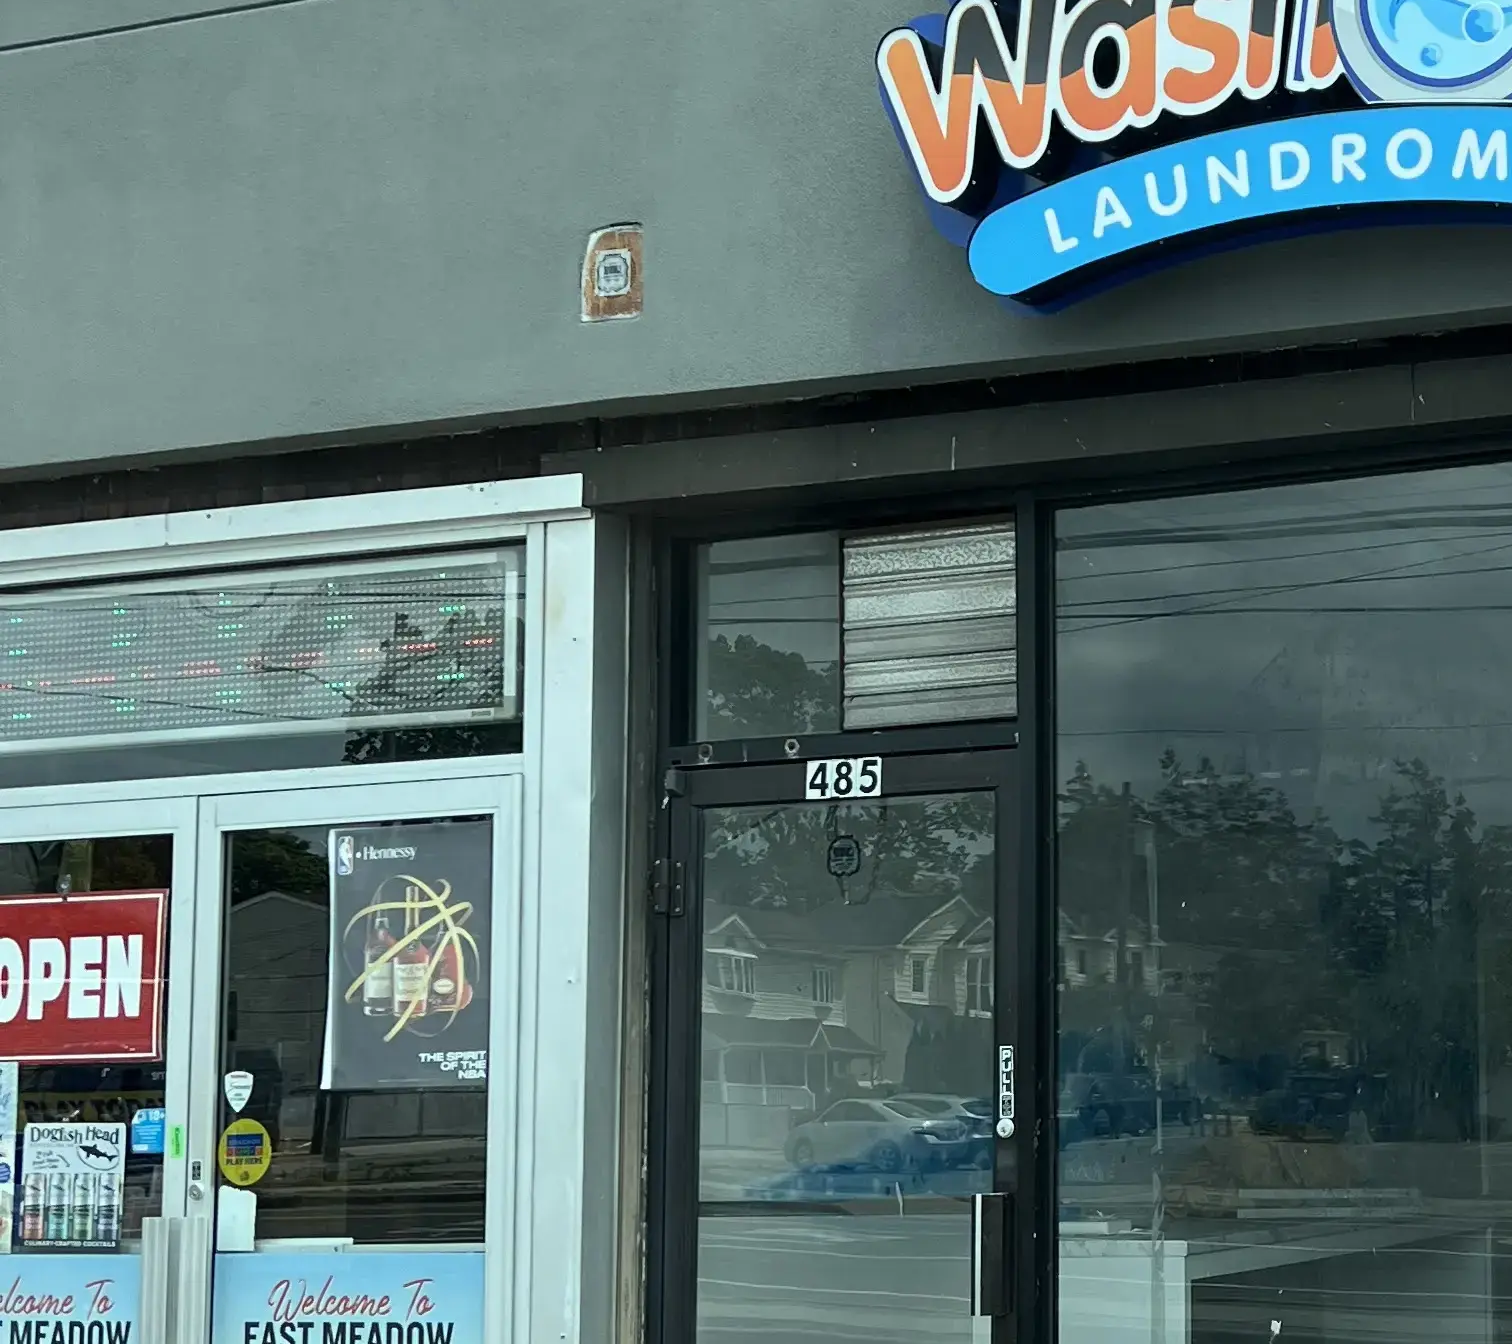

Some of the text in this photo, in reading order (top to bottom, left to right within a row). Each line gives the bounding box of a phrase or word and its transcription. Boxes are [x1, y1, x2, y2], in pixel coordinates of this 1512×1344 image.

[808, 758, 880, 798] 485
[363, 845, 417, 861] Hennessy
[0, 934, 143, 1023] OPEN
[418, 1050, 487, 1063] THE SPIRIT
[440, 1060, 487, 1071] OF THE
[1002, 1048, 1012, 1094] PULL
[457, 1069, 487, 1080] NBA
[85, 1125, 119, 1145] Head
[85, 1279, 115, 1321] To
[268, 1275, 435, 1322] Welcome To
